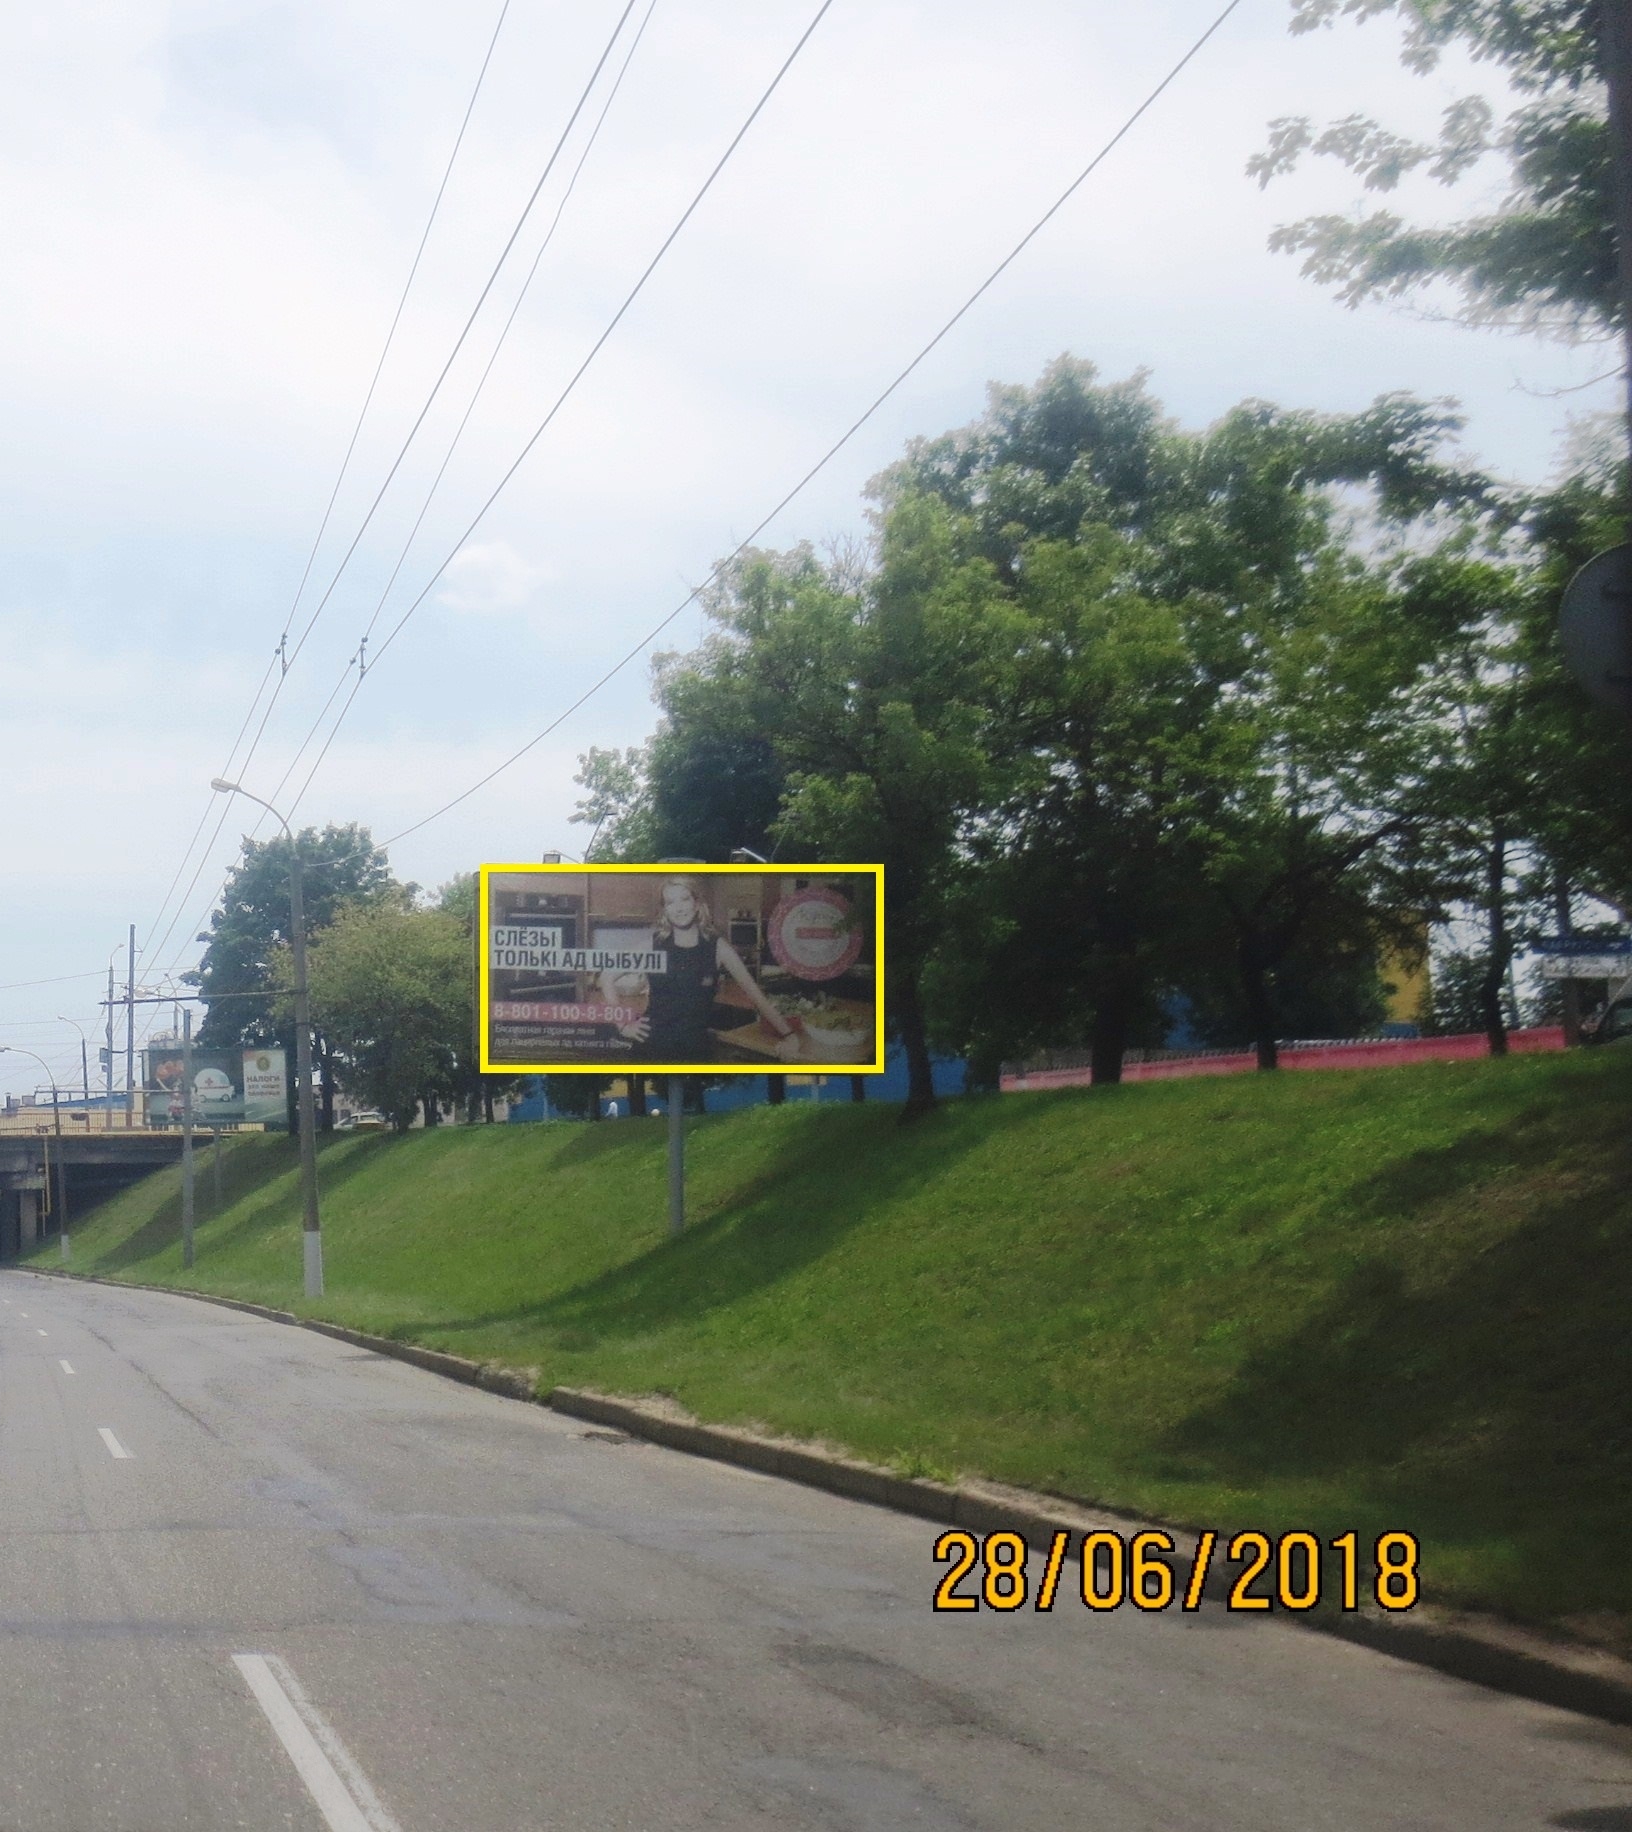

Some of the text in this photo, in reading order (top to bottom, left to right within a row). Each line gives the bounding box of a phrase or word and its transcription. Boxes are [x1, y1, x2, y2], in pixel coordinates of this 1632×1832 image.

[494, 927, 556, 947] СЛЁЗЫ
[494, 950, 662, 972] ТОЛЬКІ АД ЦЫБУЛІ
[494, 1004, 632, 1021] 8-801-100-8-801
